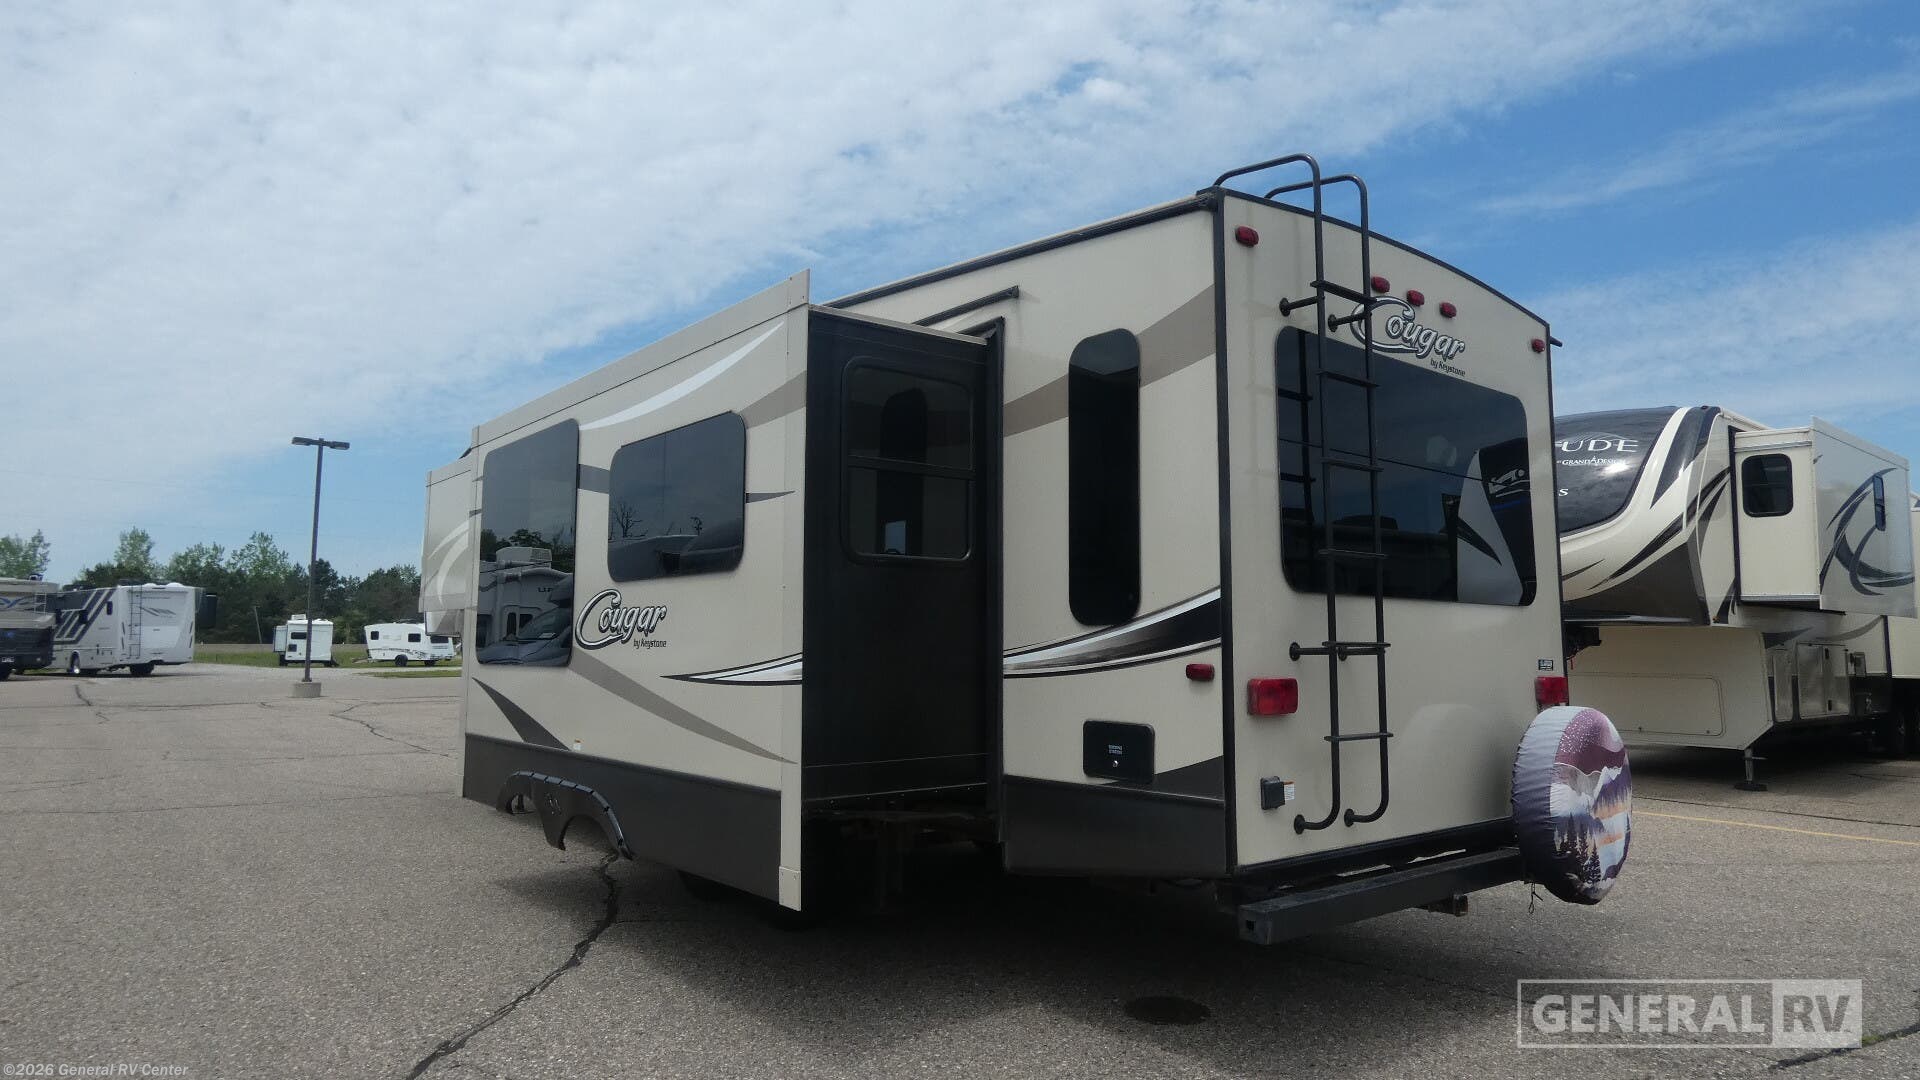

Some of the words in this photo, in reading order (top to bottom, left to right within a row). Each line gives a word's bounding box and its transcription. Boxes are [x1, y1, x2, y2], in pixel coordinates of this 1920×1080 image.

[1350, 296, 1465, 361] Cougar
[1430, 358, 1439, 369] by
[1439, 361, 1466, 377] Keystone
[1555, 439, 1639, 453] UDE
[575, 588, 667, 650] Cougar
[633, 638, 640, 649] by
[640, 638, 667, 650] Keystone
